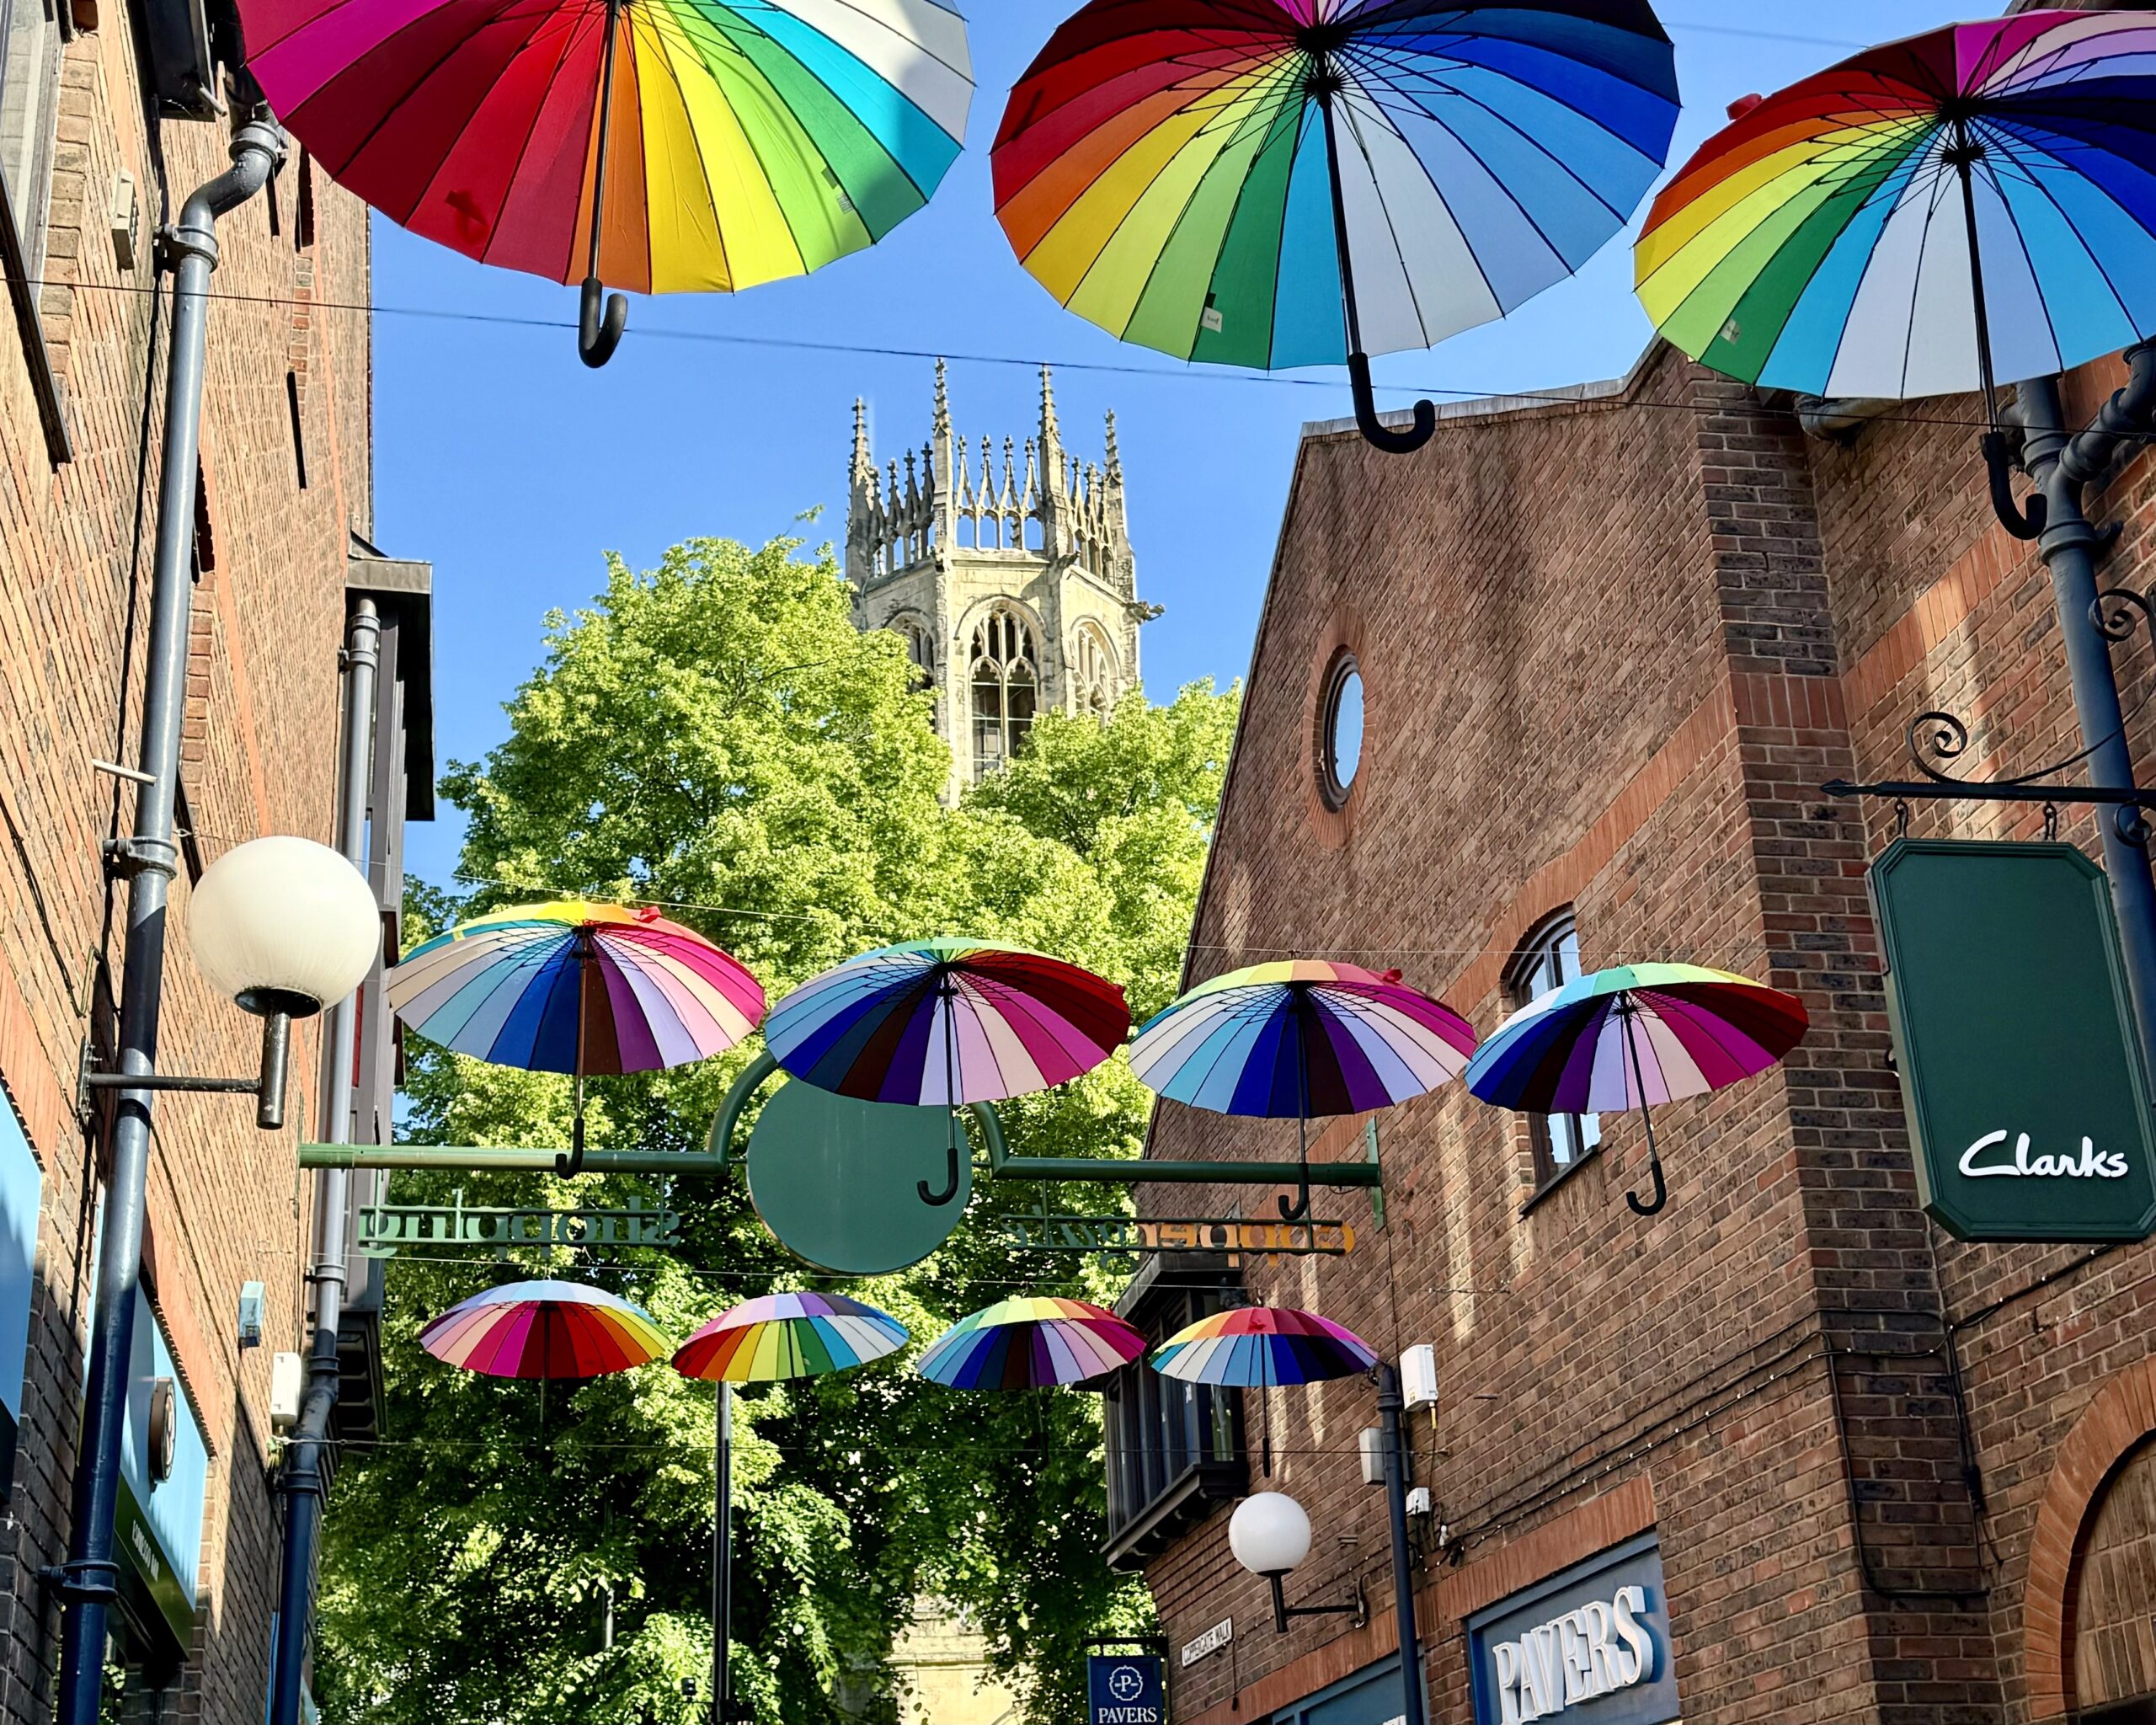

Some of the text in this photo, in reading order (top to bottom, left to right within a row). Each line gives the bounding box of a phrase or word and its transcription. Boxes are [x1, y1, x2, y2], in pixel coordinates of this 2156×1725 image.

[1958, 1130, 2129, 1178] Clarks
[1492, 1586, 1653, 1725] PAVERS
[1098, 1706, 1157, 1724] PAVERS
